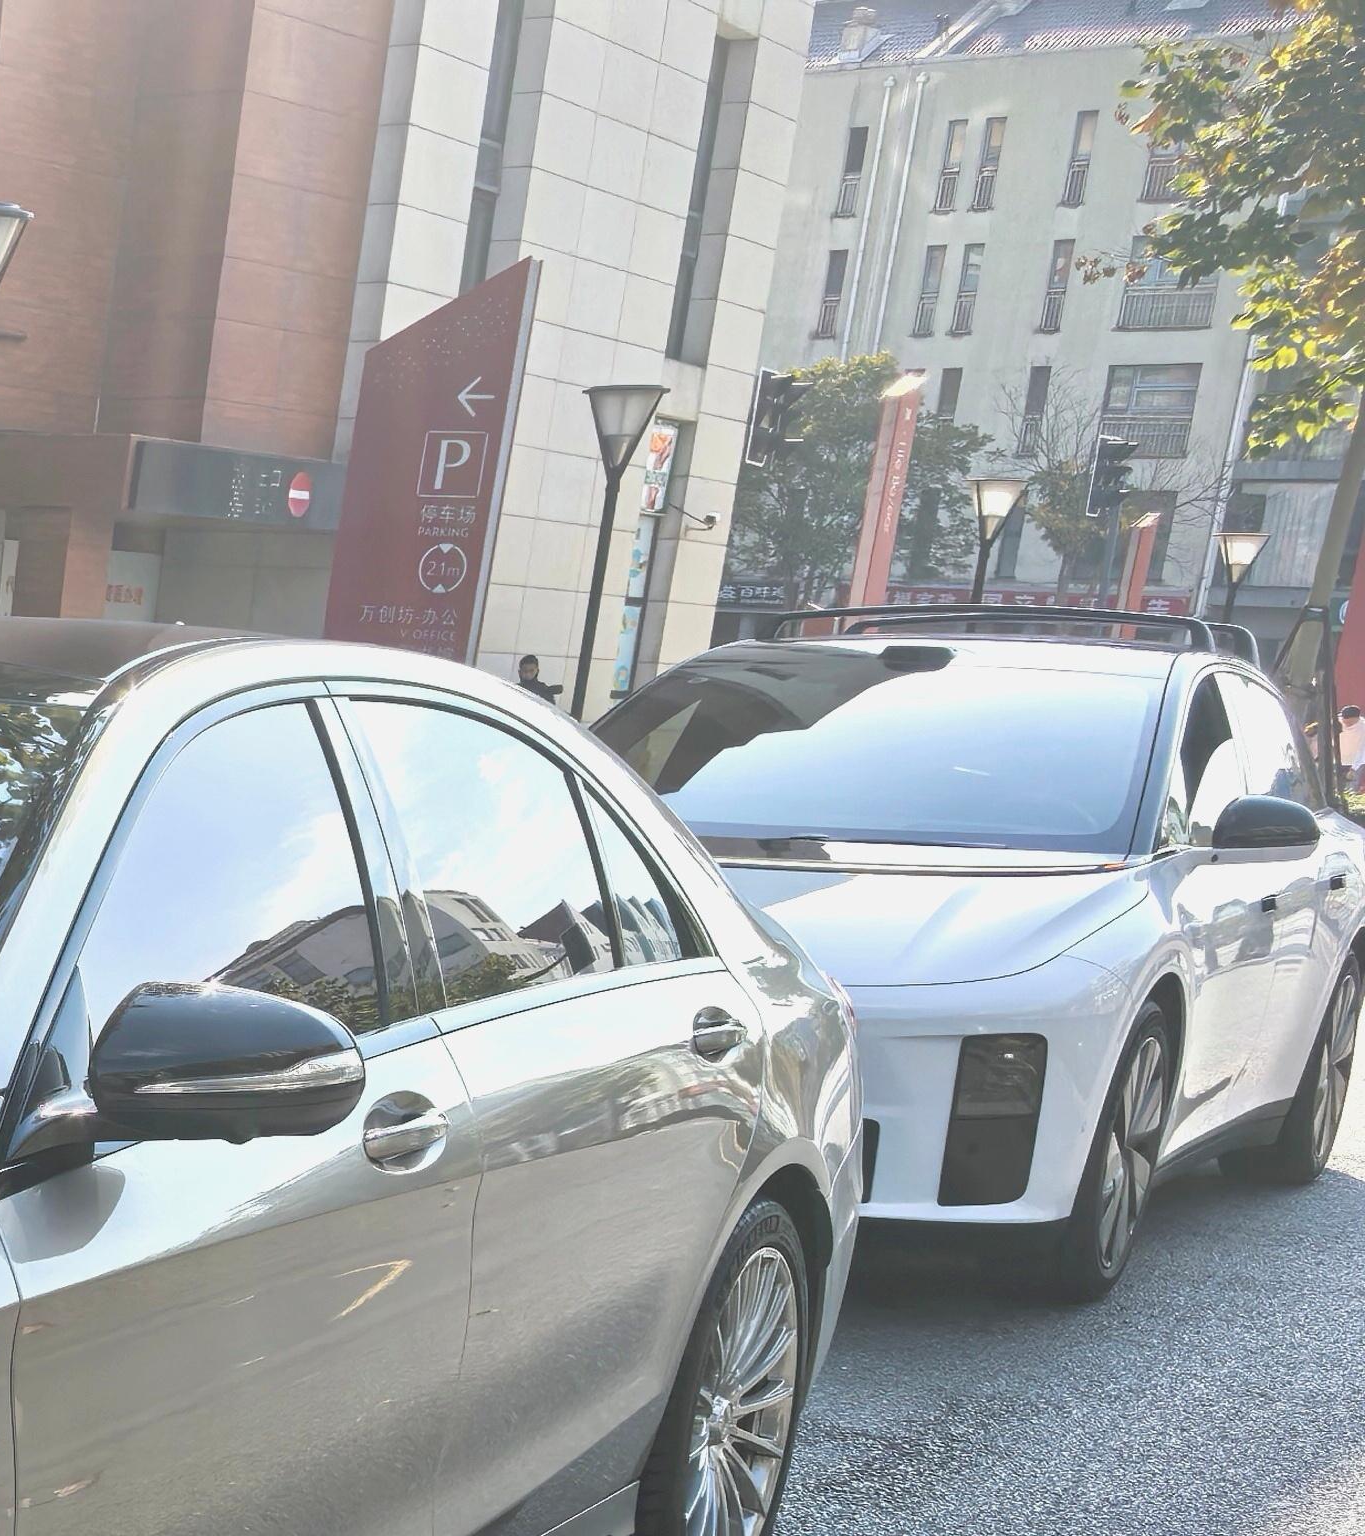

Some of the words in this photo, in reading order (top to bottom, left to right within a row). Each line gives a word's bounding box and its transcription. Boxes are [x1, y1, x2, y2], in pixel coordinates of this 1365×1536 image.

[433, 438, 471, 490] P
[420, 503, 477, 525] 停车场
[418, 526, 470, 538] PARKING
[412, 629, 455, 641] OFFICE
